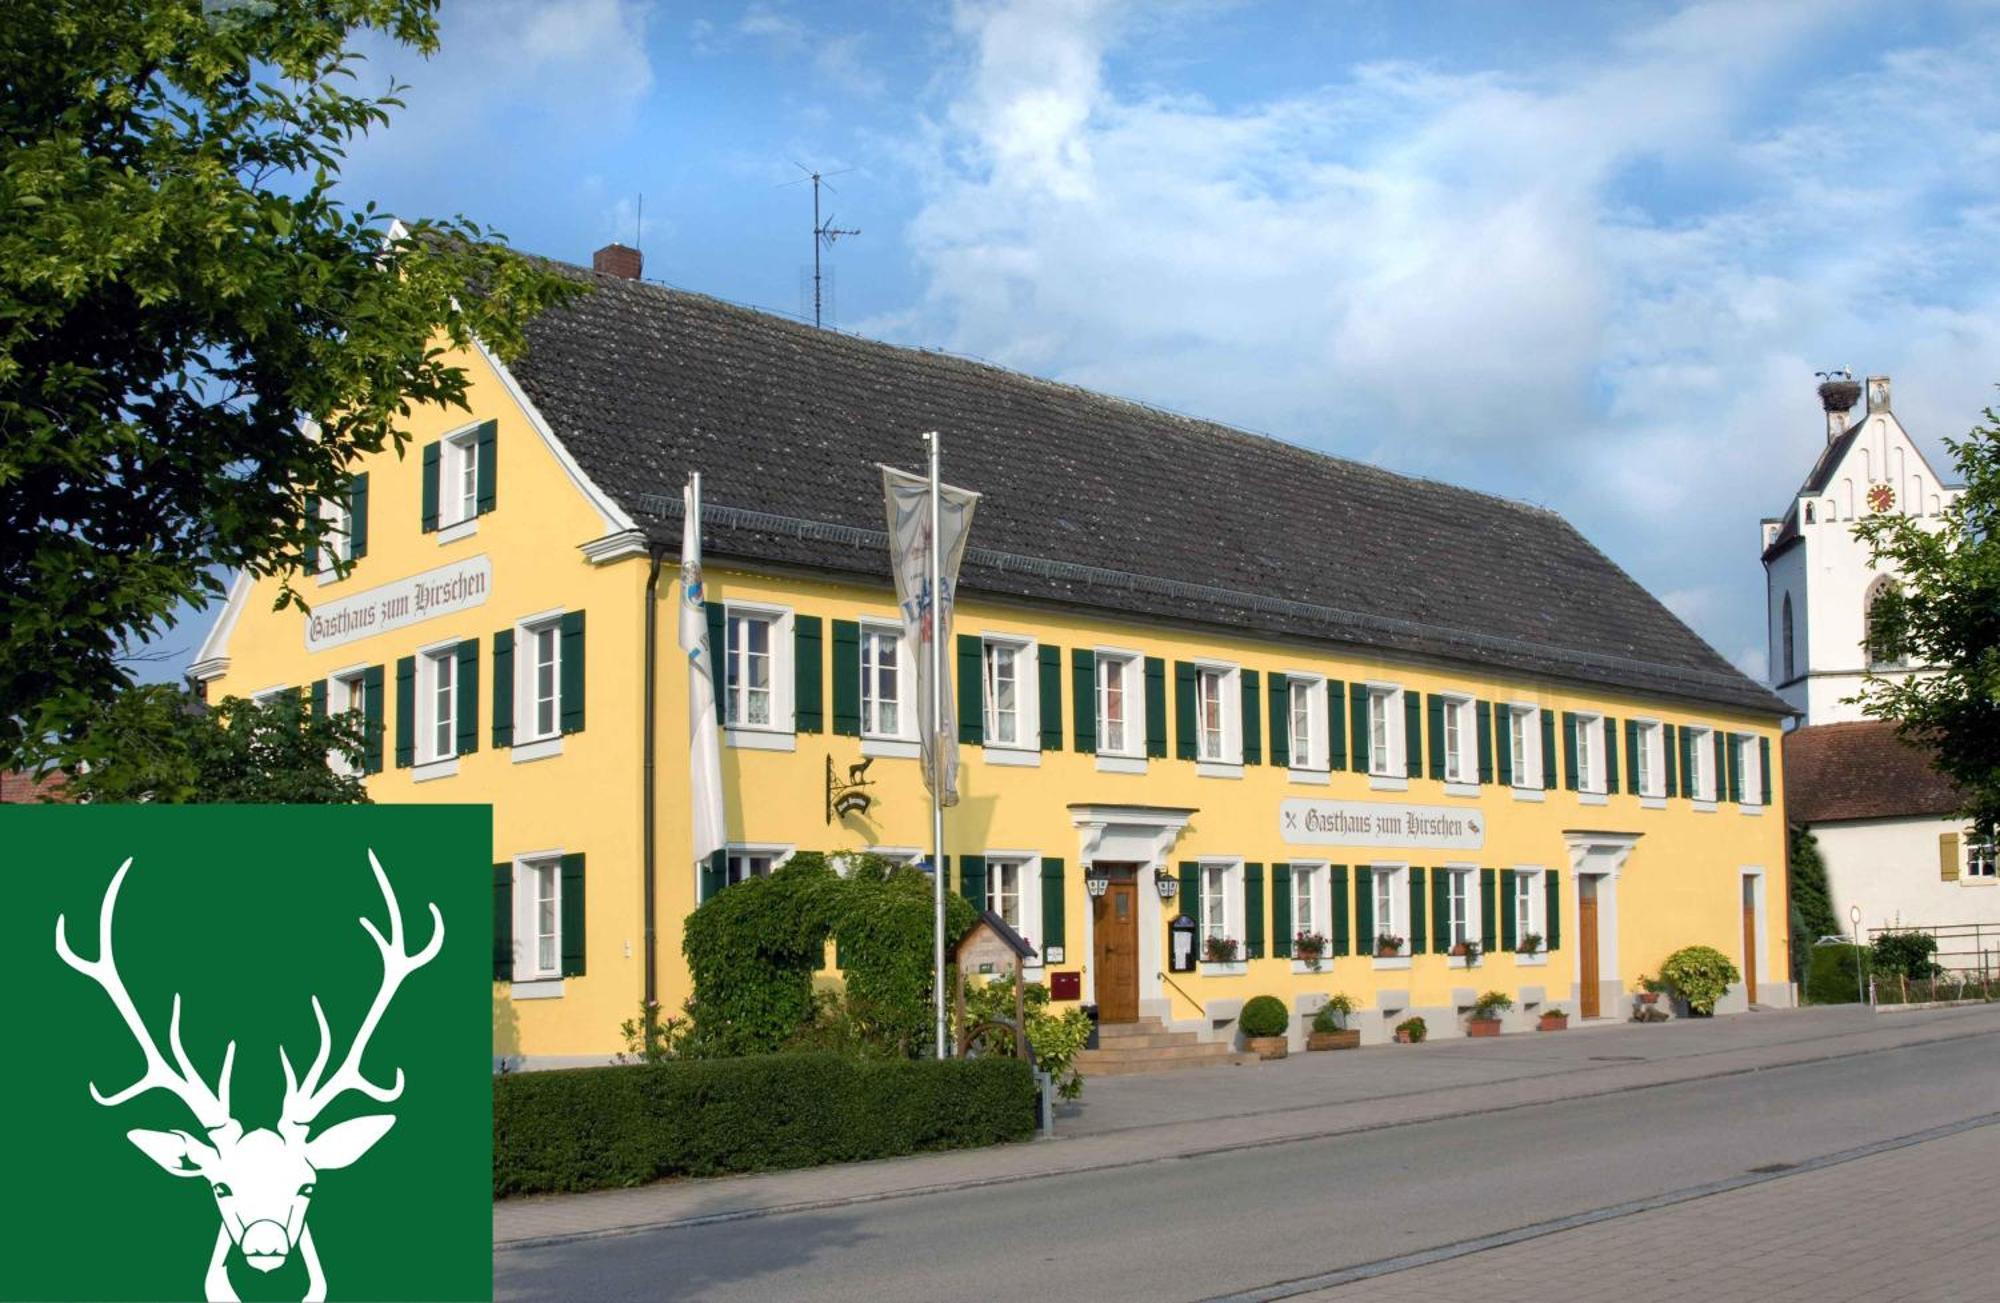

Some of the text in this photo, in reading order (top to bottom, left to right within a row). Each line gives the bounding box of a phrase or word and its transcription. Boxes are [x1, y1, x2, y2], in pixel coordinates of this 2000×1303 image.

[310, 572, 485, 642] Gasthaus zum Hirschen
[1305, 808, 1463, 838] Gasthaus zum Hirschen
